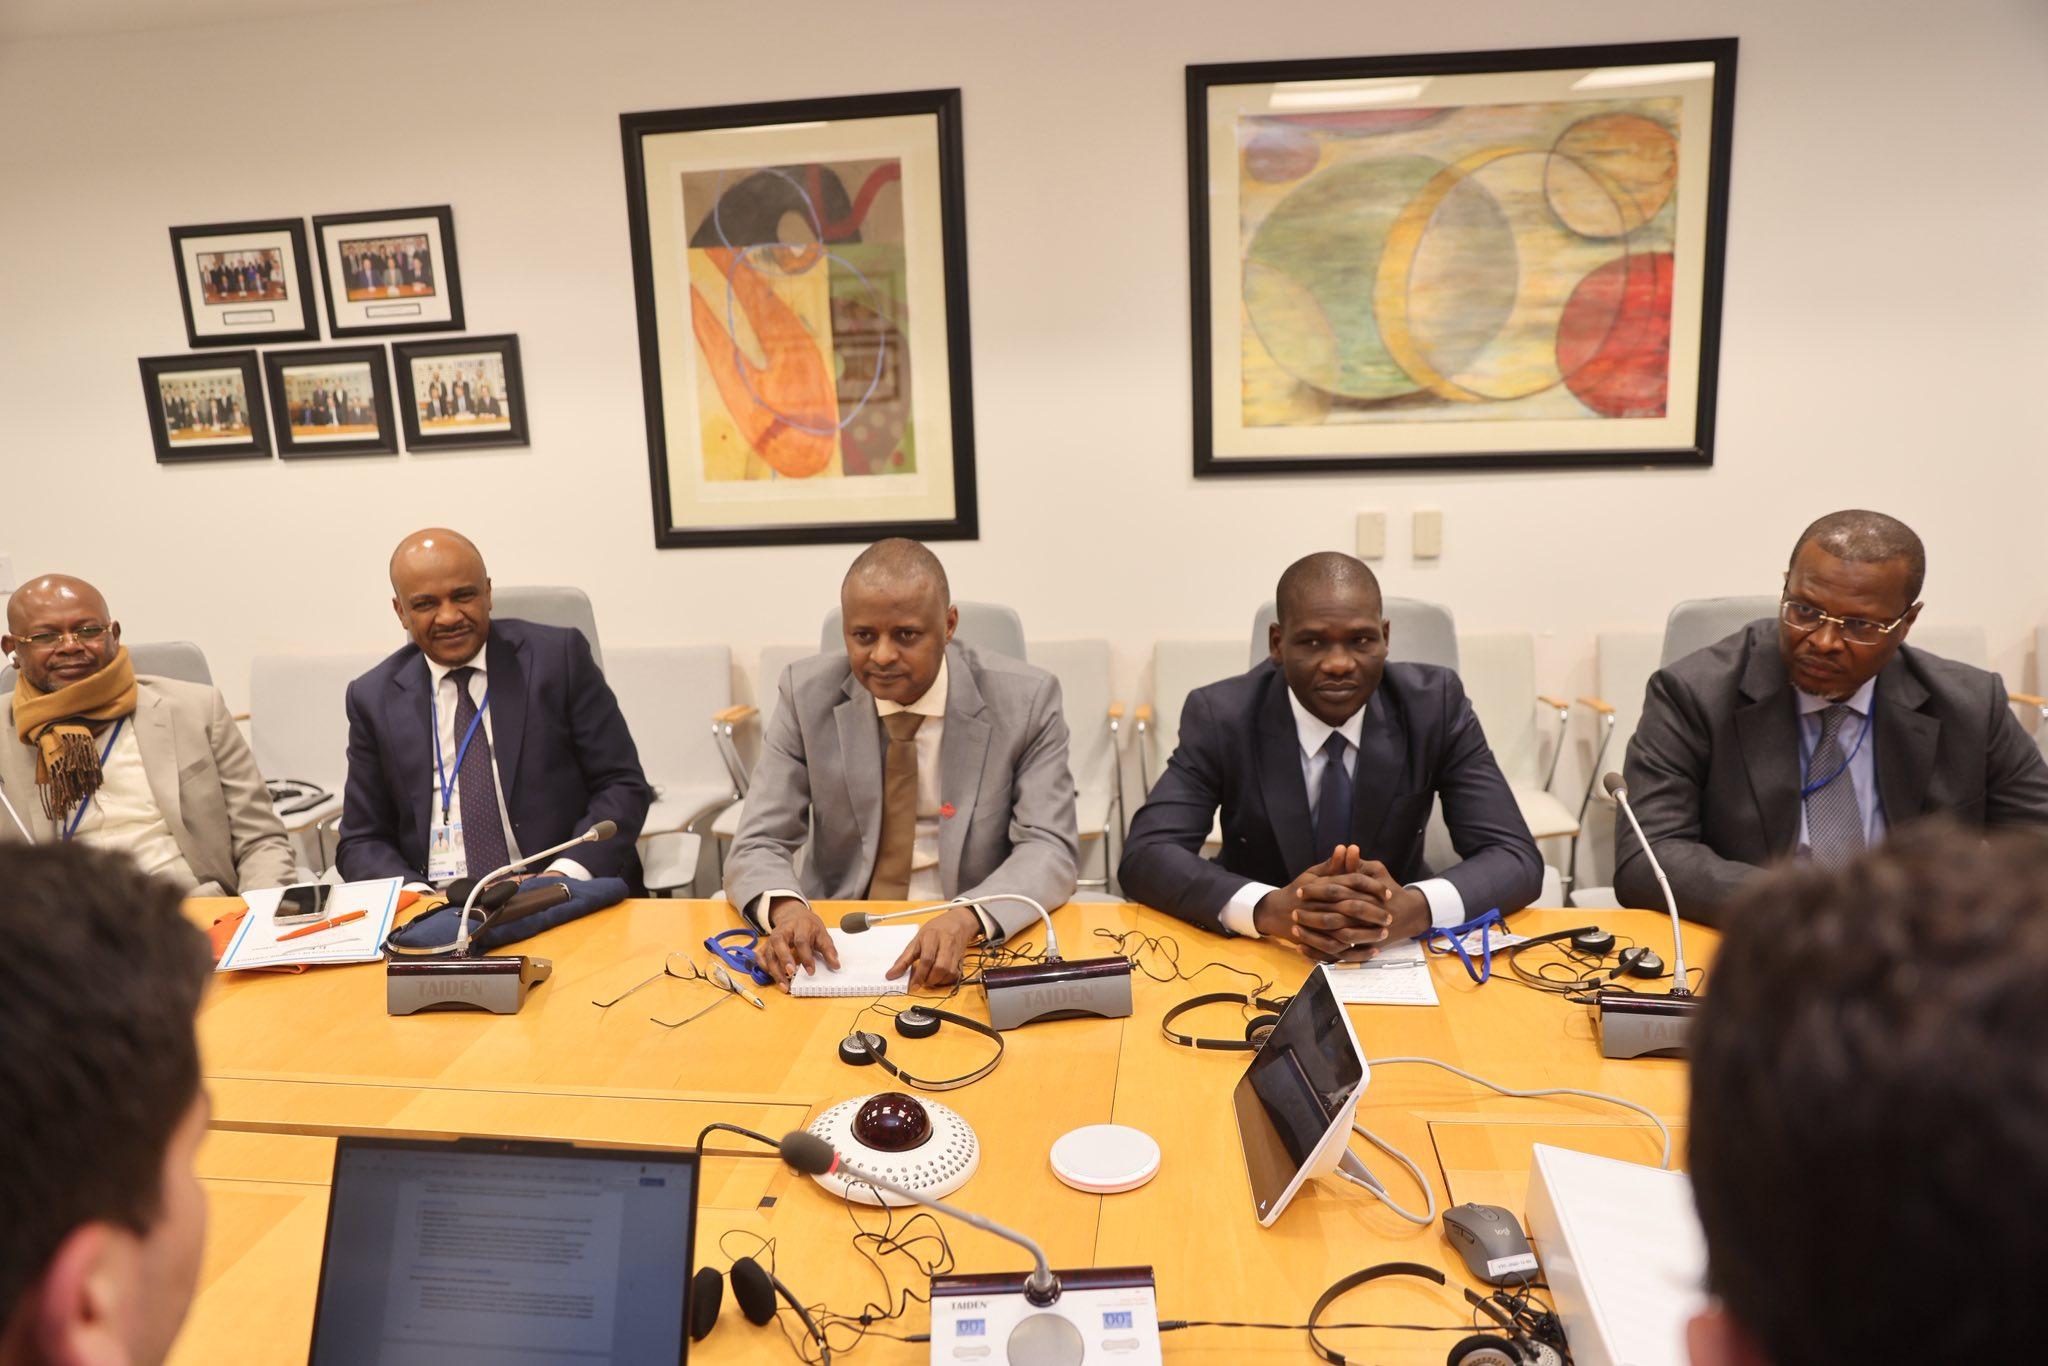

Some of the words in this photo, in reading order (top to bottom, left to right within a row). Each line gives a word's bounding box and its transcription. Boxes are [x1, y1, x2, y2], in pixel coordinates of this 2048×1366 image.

[416, 980, 482, 997] TAIDEN
[1021, 985, 1094, 1009] TAIDEN
[951, 1300, 988, 1311] TAIDEN
